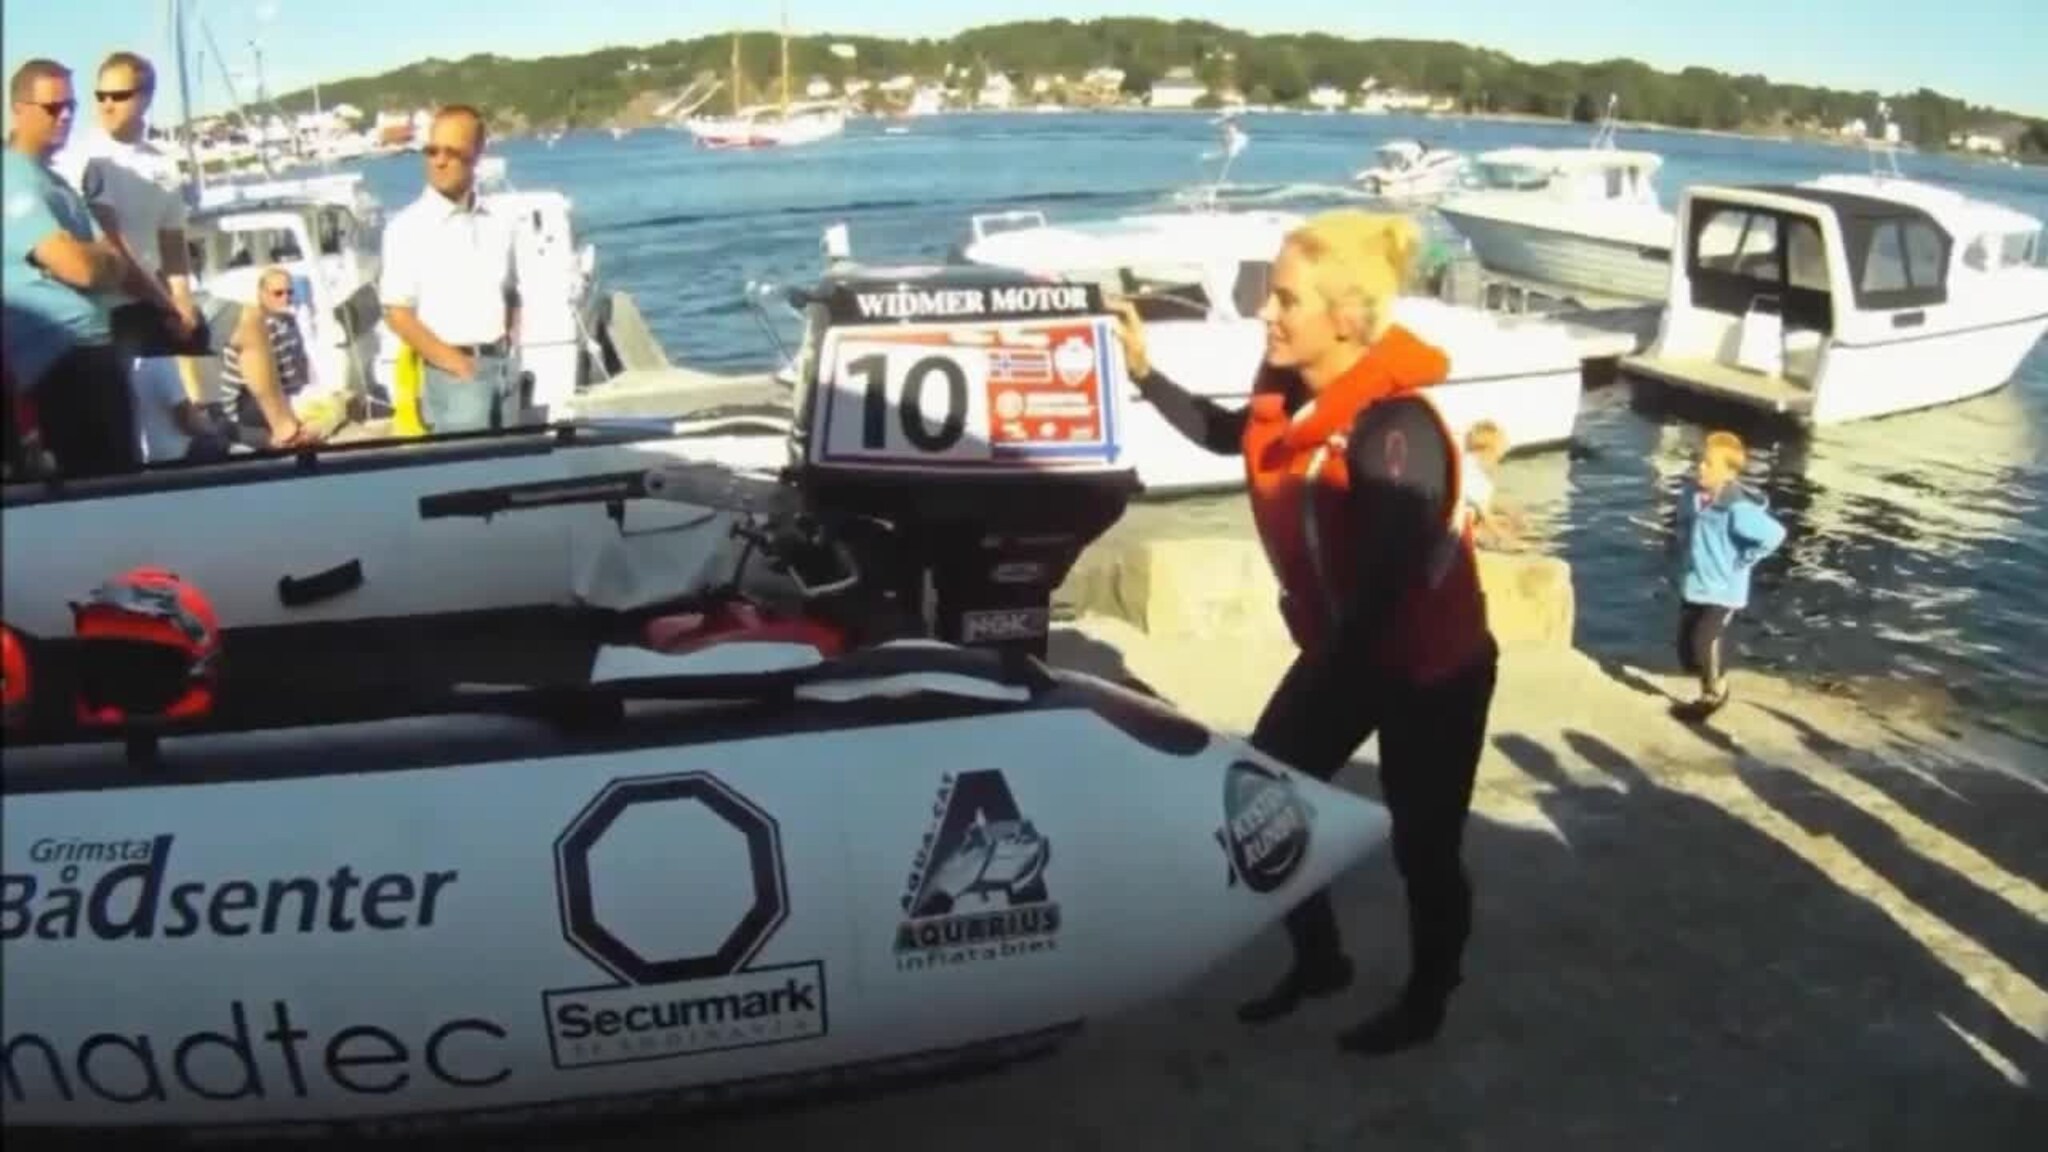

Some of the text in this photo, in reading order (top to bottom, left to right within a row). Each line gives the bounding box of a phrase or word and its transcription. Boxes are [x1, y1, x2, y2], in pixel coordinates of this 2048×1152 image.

[857, 286, 1089, 318] WIDMER MOTOR
[846, 353, 968, 453] 10
[3, 834, 458, 940] Bådsenter
[893, 901, 1062, 949] AQUARIUS
[557, 978, 815, 1040] Securmark
